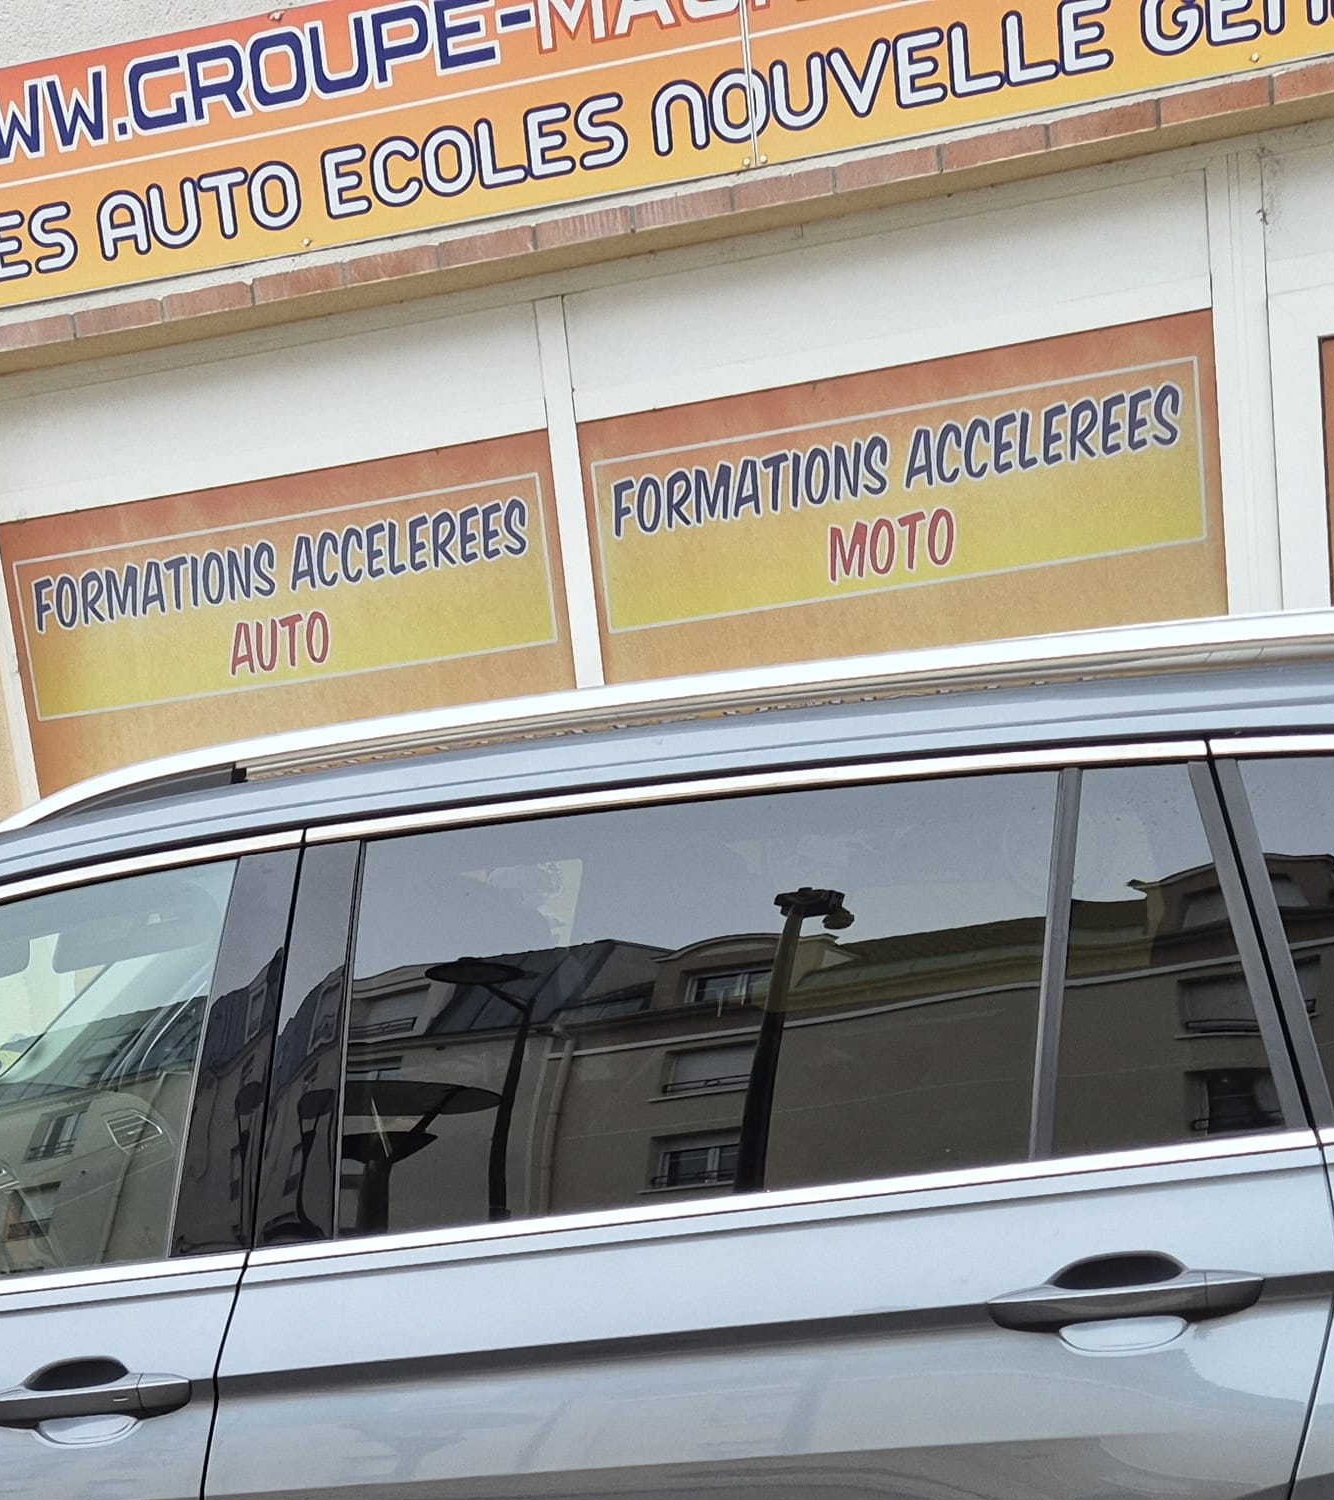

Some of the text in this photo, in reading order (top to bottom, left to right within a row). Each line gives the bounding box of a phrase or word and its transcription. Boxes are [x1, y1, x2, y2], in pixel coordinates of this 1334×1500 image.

[98, 162, 300, 262] AUTO
[321, 93, 628, 220] ECOLES
[652, 0, 1113, 157] NOUVELLE
[610, 382, 1182, 539] FORMATIONS ACCELEREES
[31, 499, 530, 634] FORMATIONS ACCELEREES
[826, 507, 956, 585] MOTO
[229, 611, 331, 677] AUTO
